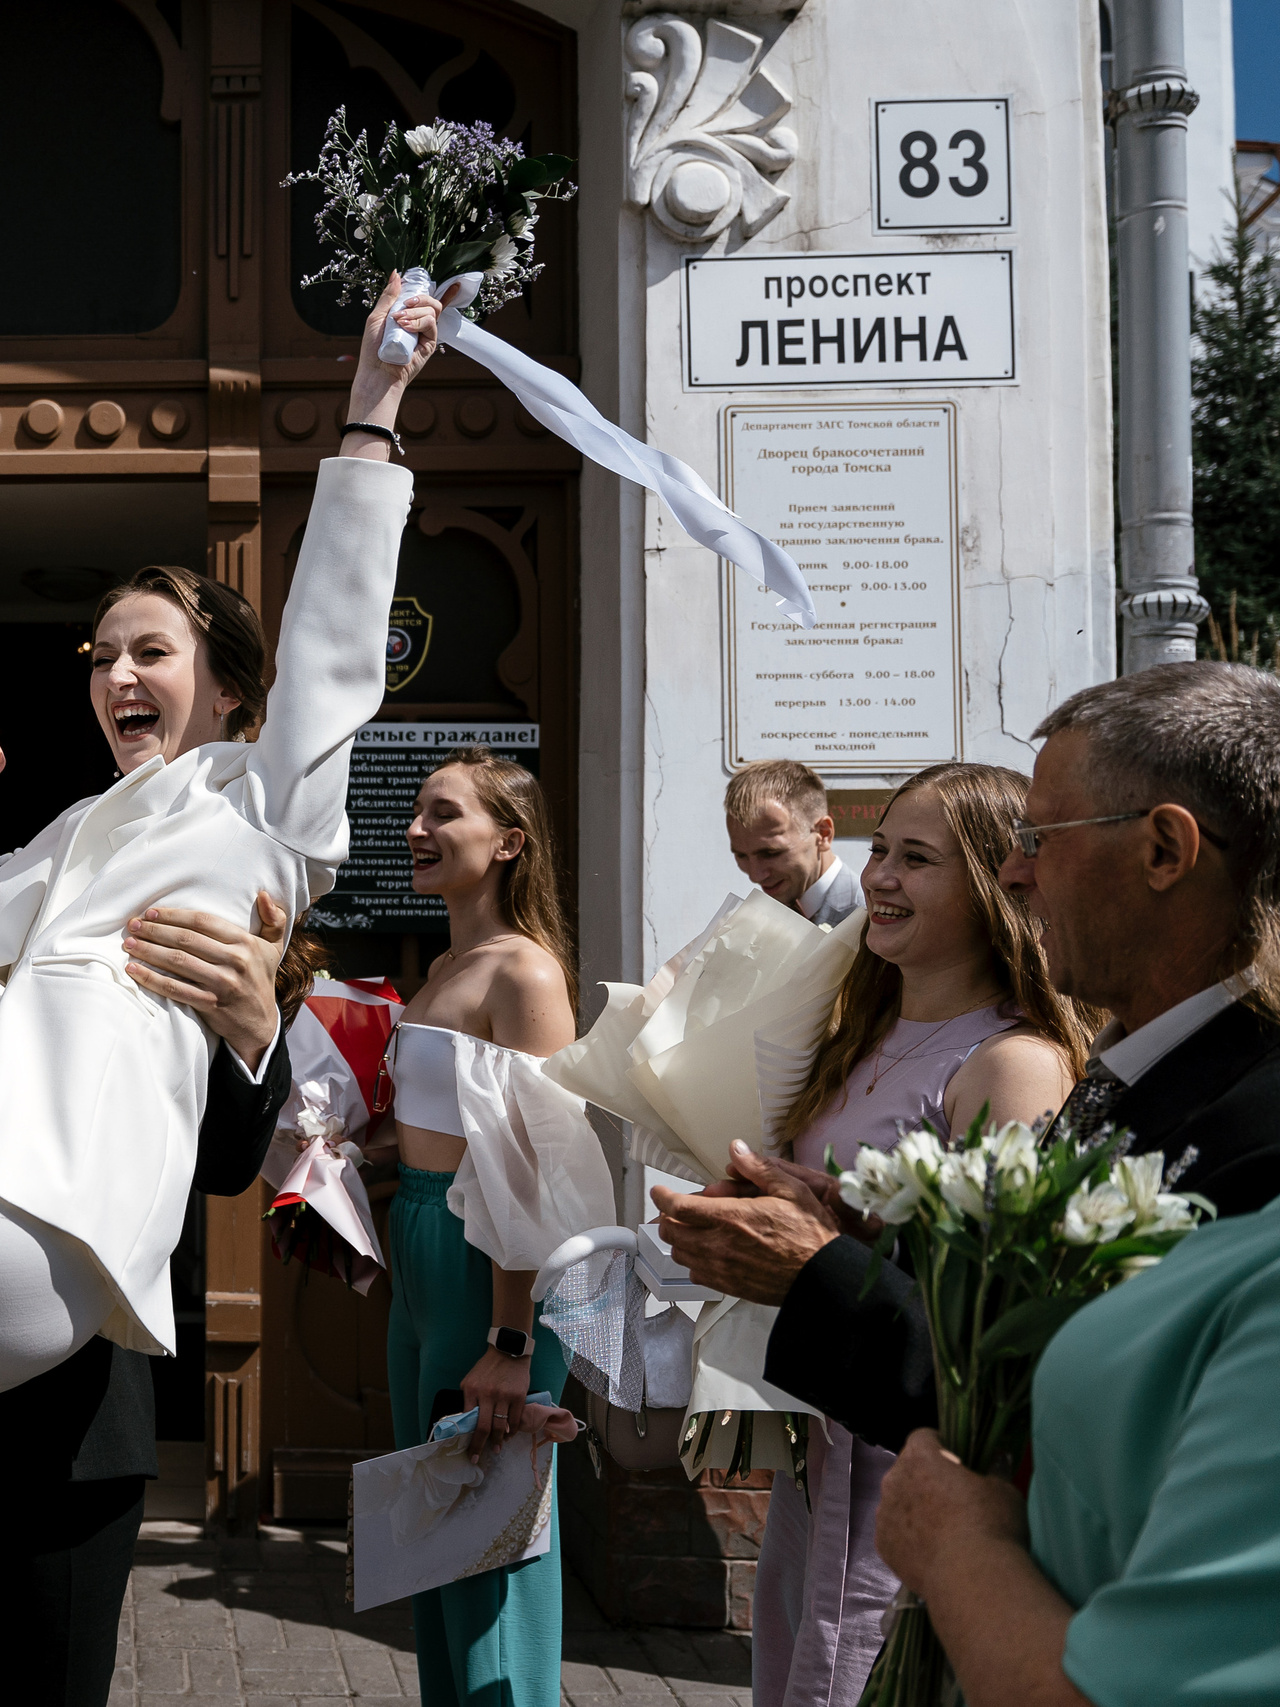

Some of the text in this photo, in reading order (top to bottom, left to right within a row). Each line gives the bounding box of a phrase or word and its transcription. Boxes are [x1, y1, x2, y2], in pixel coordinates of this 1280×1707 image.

[899, 129, 989, 198] 83
[764, 272, 931, 308] проспект
[736, 316, 968, 367] ЛЕНИНА
[741, 420, 940, 432] Департамент ЗАГС Томской области
[757, 446, 924, 460] Дворец бракосочетаний
[792, 462, 892, 476] города Томска
[788, 502, 895, 514] Прием заявлений
[798, 520, 904, 531] государственную
[770, 534, 944, 547] трацию заключения брака.
[798, 561, 908, 571] рник 9.00-18.00
[861, 582, 927, 591] 9.00-13.00
[751, 620, 937, 632] Государвенная регистрация
[784, 635, 904, 646] заключения брака:
[865, 671, 890, 679] 9.00
[904, 671, 936, 679] 18.00
[774, 700, 826, 709] перерыв
[839, 698, 871, 707] 13.00
[884, 698, 916, 706] 14.00
[424, 728, 536, 745] граждане!
[760, 730, 837, 740] воскресенье
[849, 730, 929, 740] понедельник
[814, 742, 876, 752] выходной
[352, 753, 406, 762] истрации
[350, 788, 416, 797] помещения
[351, 797, 414, 809] убедитель
[351, 896, 400, 906] Заранее
